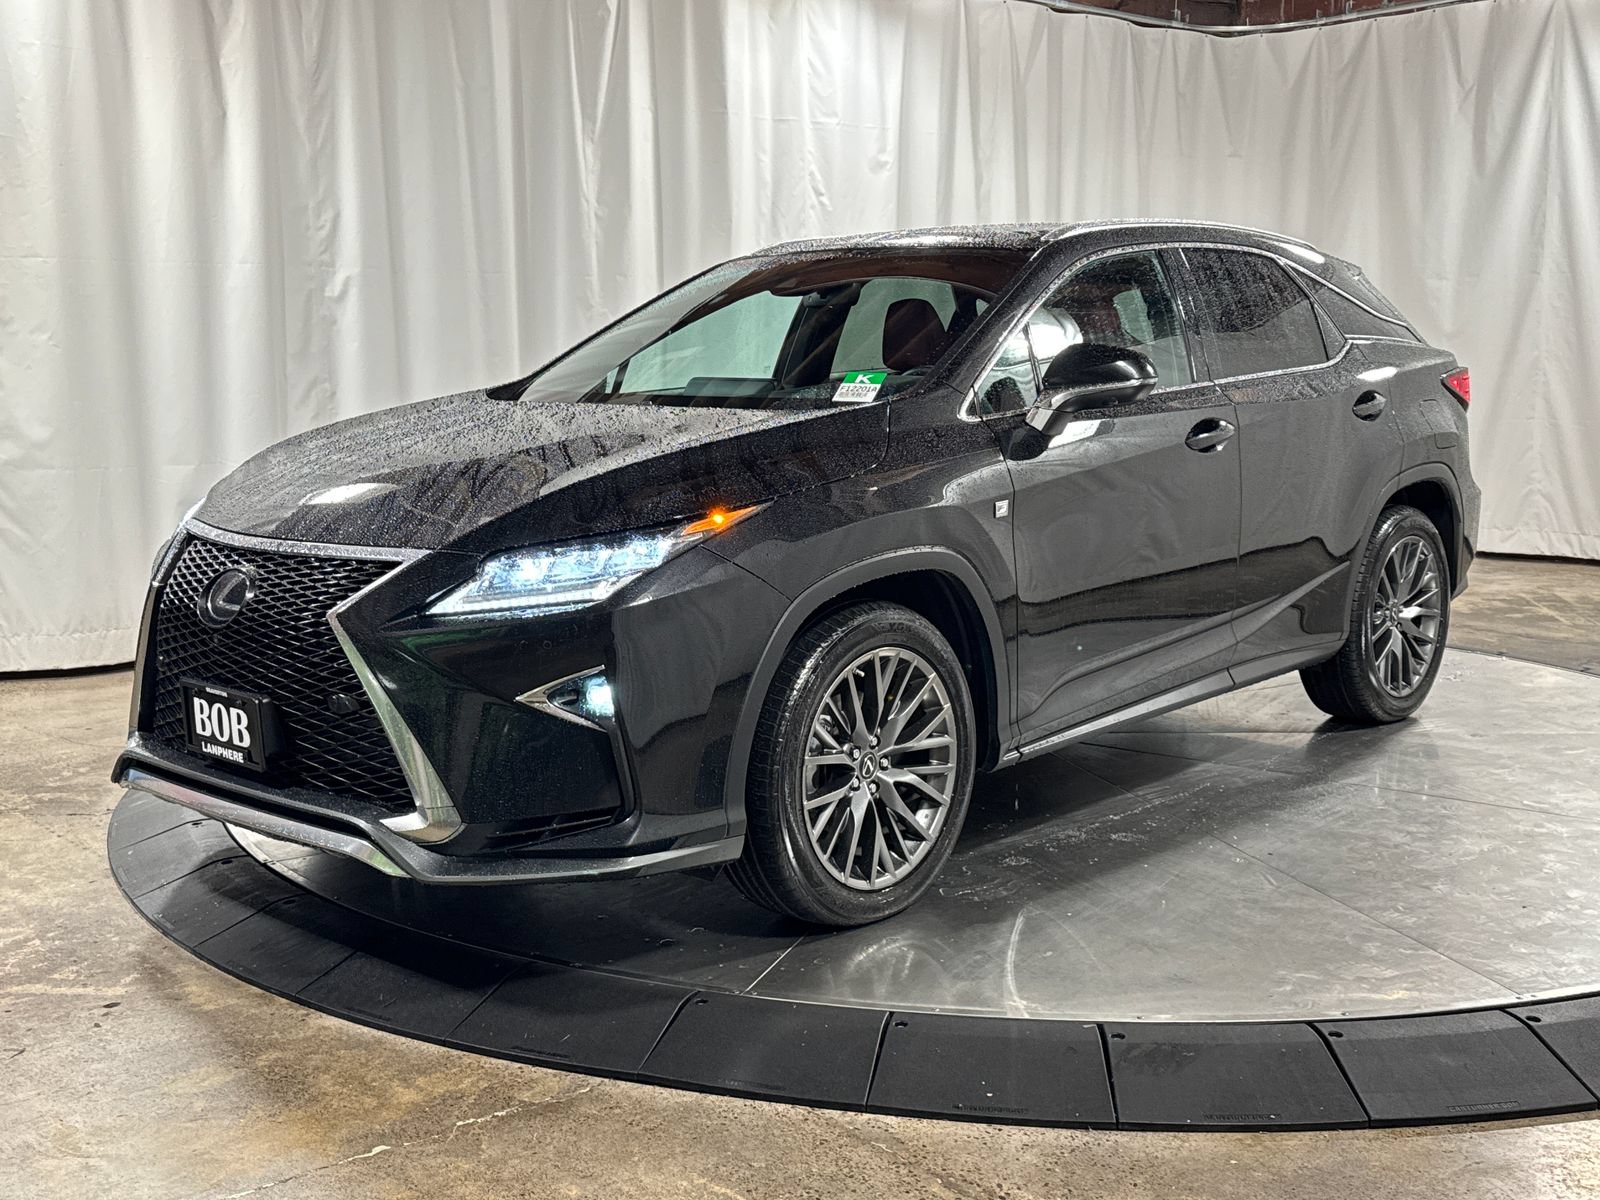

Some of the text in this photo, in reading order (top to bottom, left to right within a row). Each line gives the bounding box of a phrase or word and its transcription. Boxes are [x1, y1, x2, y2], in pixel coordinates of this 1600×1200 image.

[854, 374, 874, 384] K
[193, 697, 251, 748] BOB
[201, 741, 244, 764] LANPHERE
